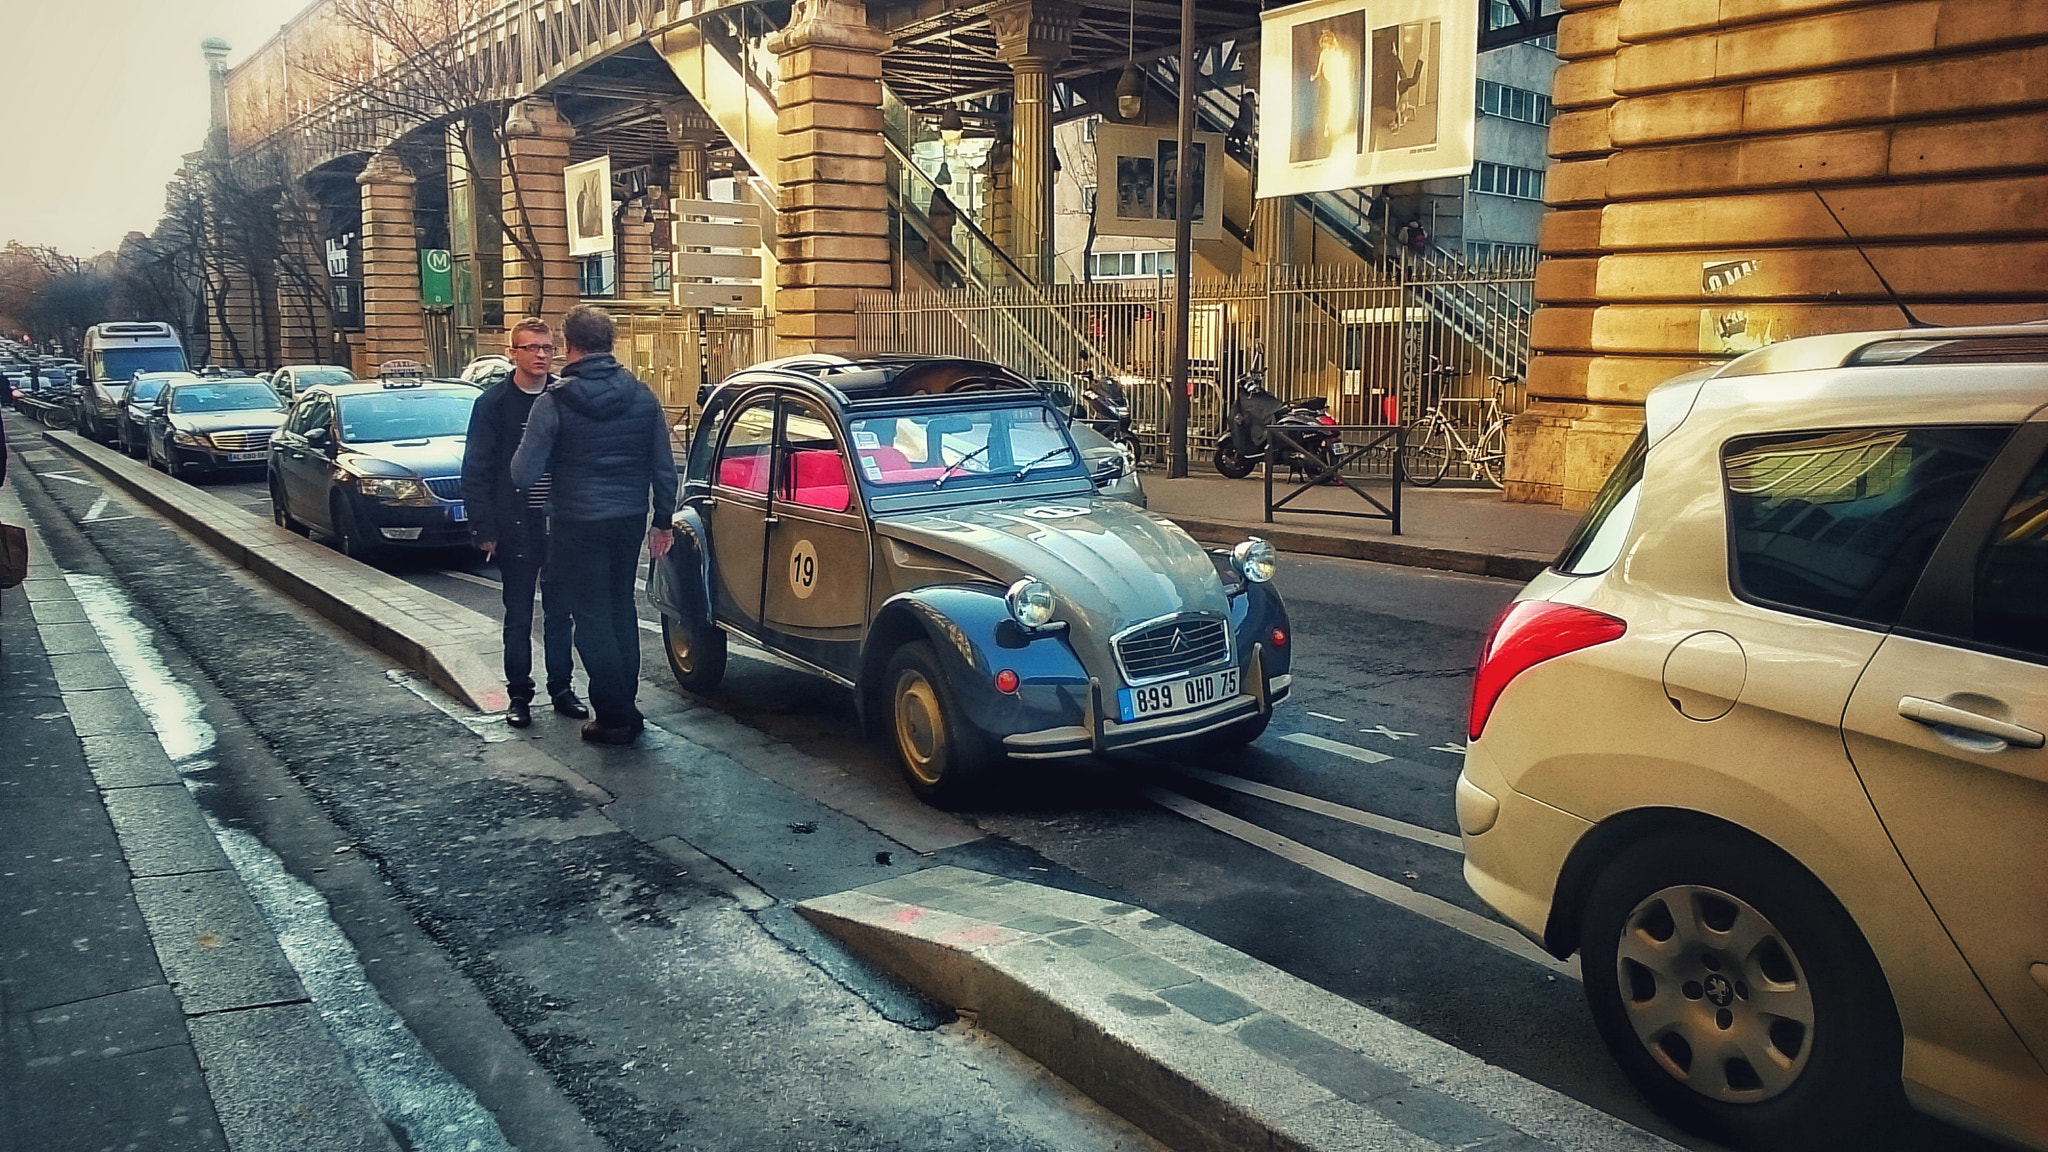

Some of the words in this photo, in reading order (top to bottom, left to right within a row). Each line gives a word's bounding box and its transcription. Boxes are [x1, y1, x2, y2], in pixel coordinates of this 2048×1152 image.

[1402, 327, 1418, 421] PHOTOS
[794, 552, 814, 587] 19
[1136, 685, 1173, 713] 899
[1185, 676, 1214, 704] QHD
[1220, 671, 1236, 697] 75
